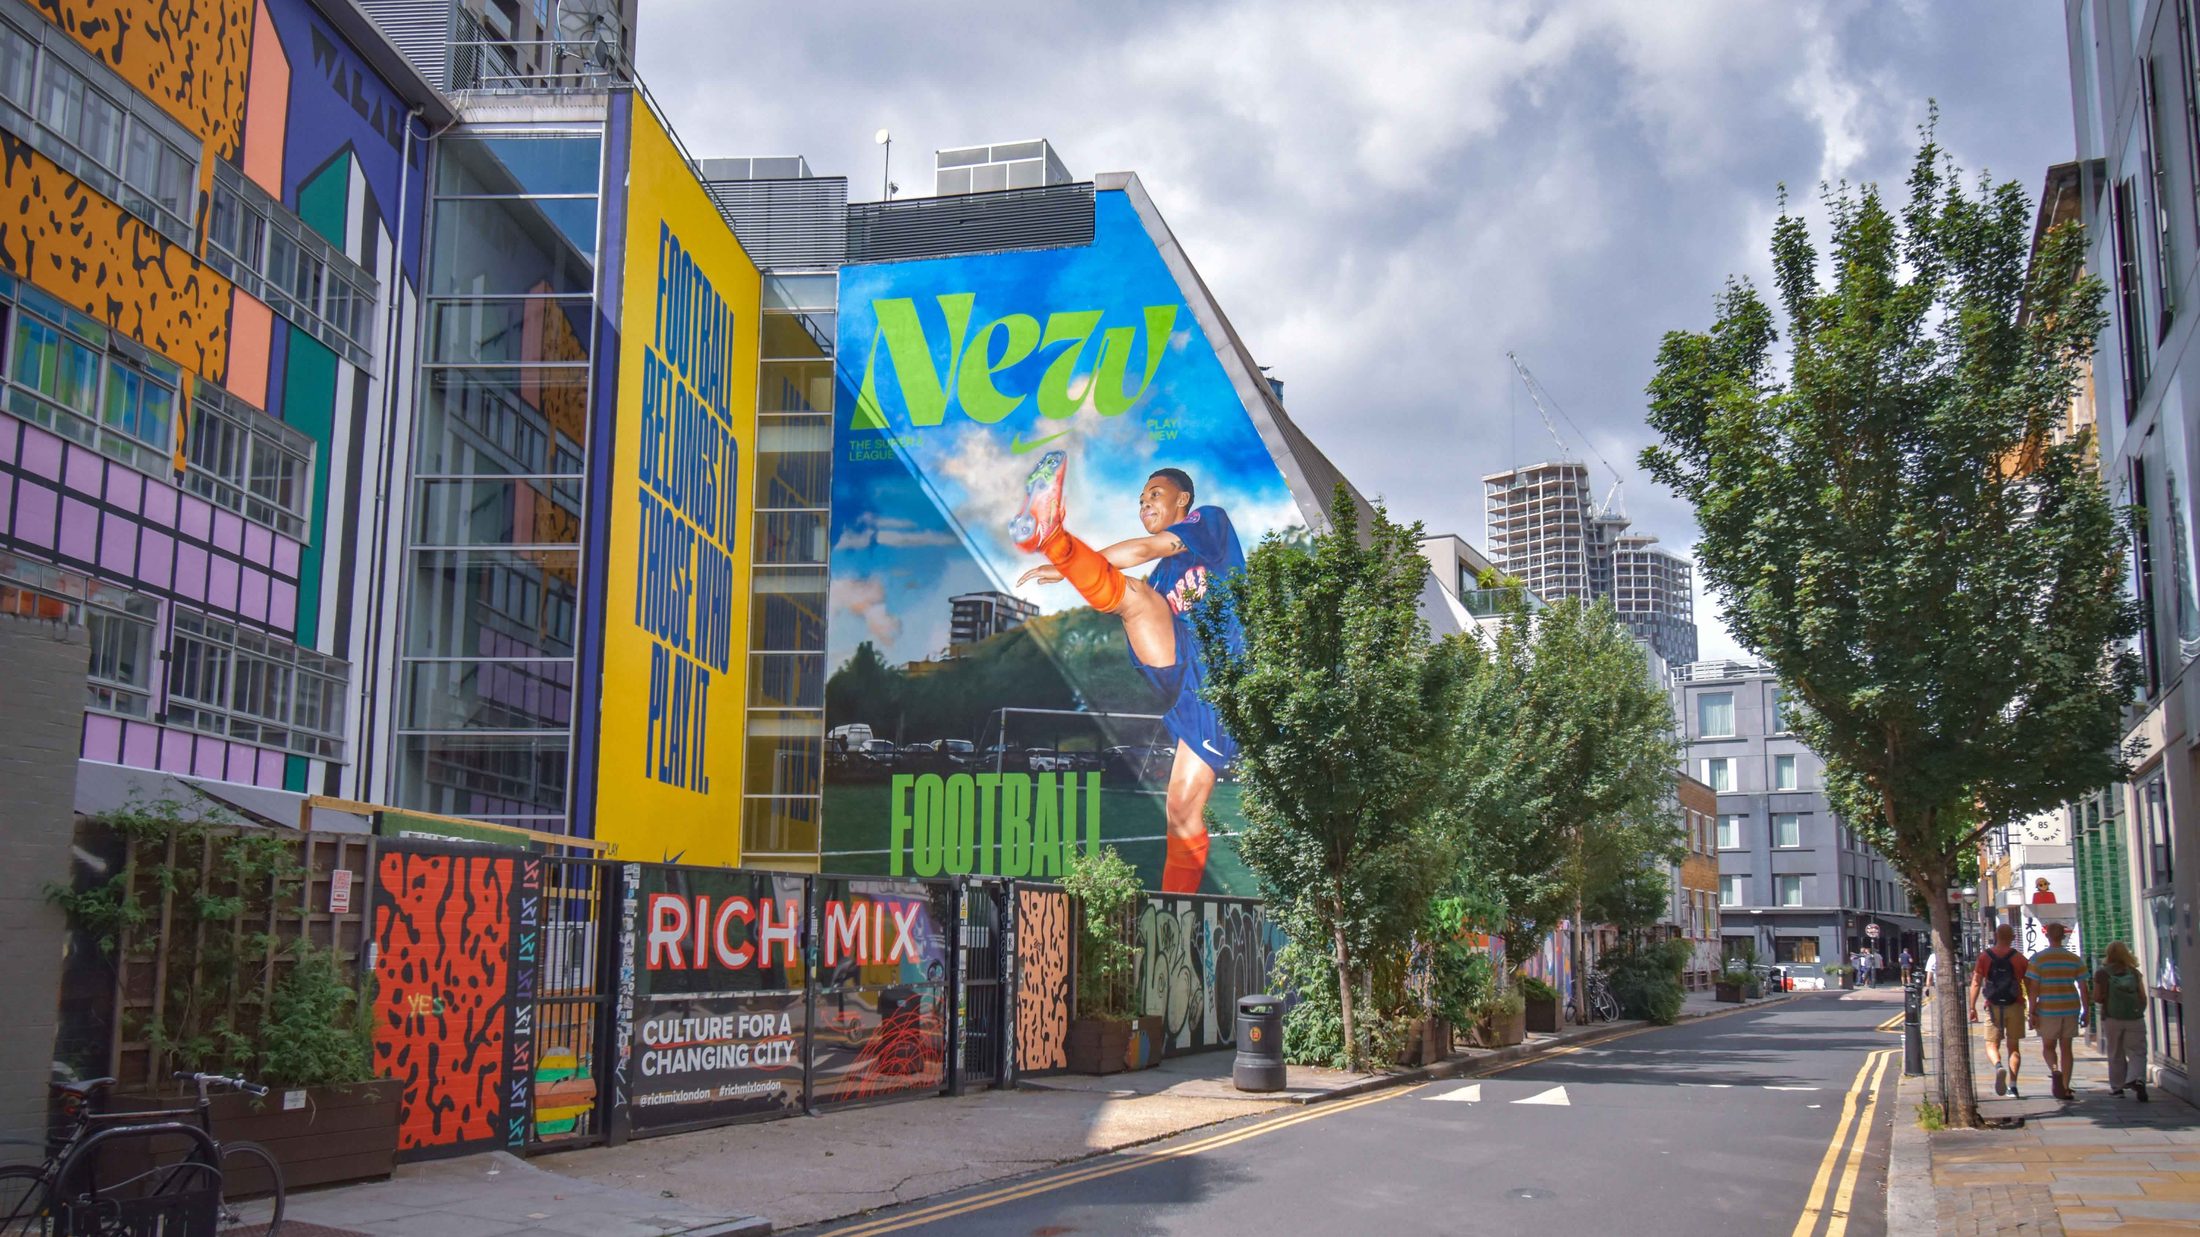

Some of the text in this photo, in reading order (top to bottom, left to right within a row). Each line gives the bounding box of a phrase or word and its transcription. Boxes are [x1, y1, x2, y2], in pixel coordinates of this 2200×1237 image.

[311, 22, 419, 172] WALALA
[655, 217, 734, 430] FOOTBALL
[850, 292, 1179, 430] New
[1147, 418, 1178, 429] PLAY
[1149, 430, 1178, 440] NEW
[638, 343, 738, 555] BELONGS TO
[849, 439, 871, 450] THE
[849, 450, 894, 461] LEAGUE
[635, 484, 733, 675] THOSE WHO
[645, 640, 709, 795] PLAY IT.
[890, 771, 1101, 877] FOOTBALL
[2025, 827, 2061, 842] AND WAIT
[2038, 821, 2048, 829] 85
[646, 893, 798, 970] RICH
[824, 901, 921, 967] MIX
[408, 993, 444, 1017] YES
[642, 1013, 792, 1045] CULTURE FOR A
[641, 1040, 796, 1077] CHANGING CITY
[640, 1080, 781, 1108] @richmixlondon #richmixlondon
